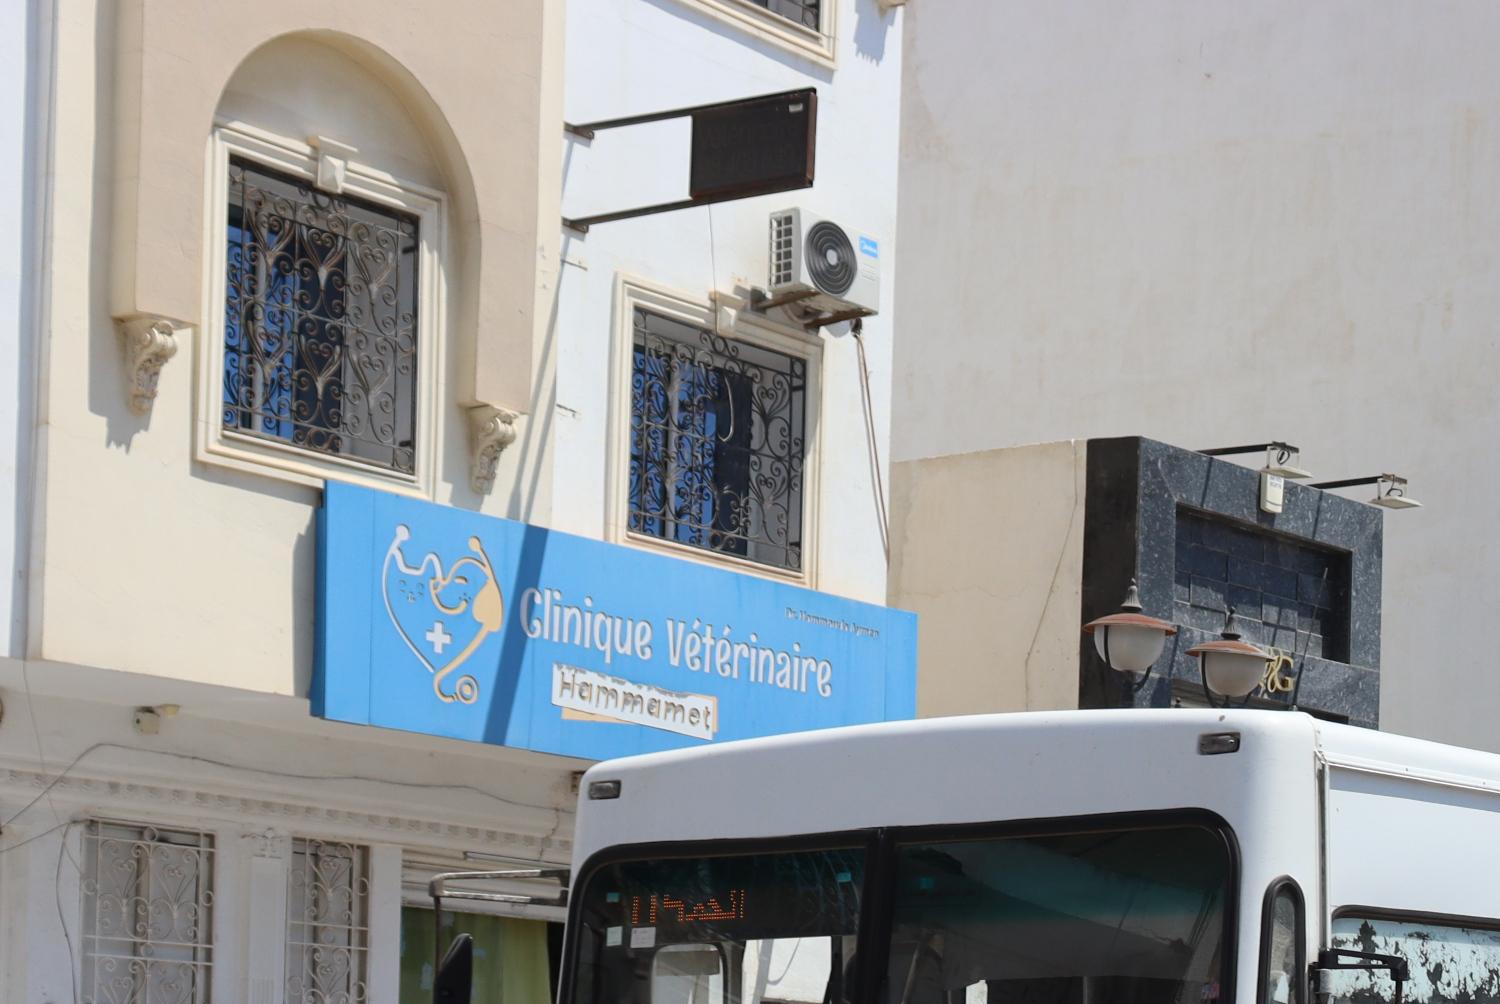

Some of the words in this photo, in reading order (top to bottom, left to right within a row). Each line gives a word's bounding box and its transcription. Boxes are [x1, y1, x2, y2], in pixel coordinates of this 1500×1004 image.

[520, 587, 653, 665] Clinique
[666, 617, 833, 698] Vétérinaire
[557, 670, 712, 730] Hammamet
